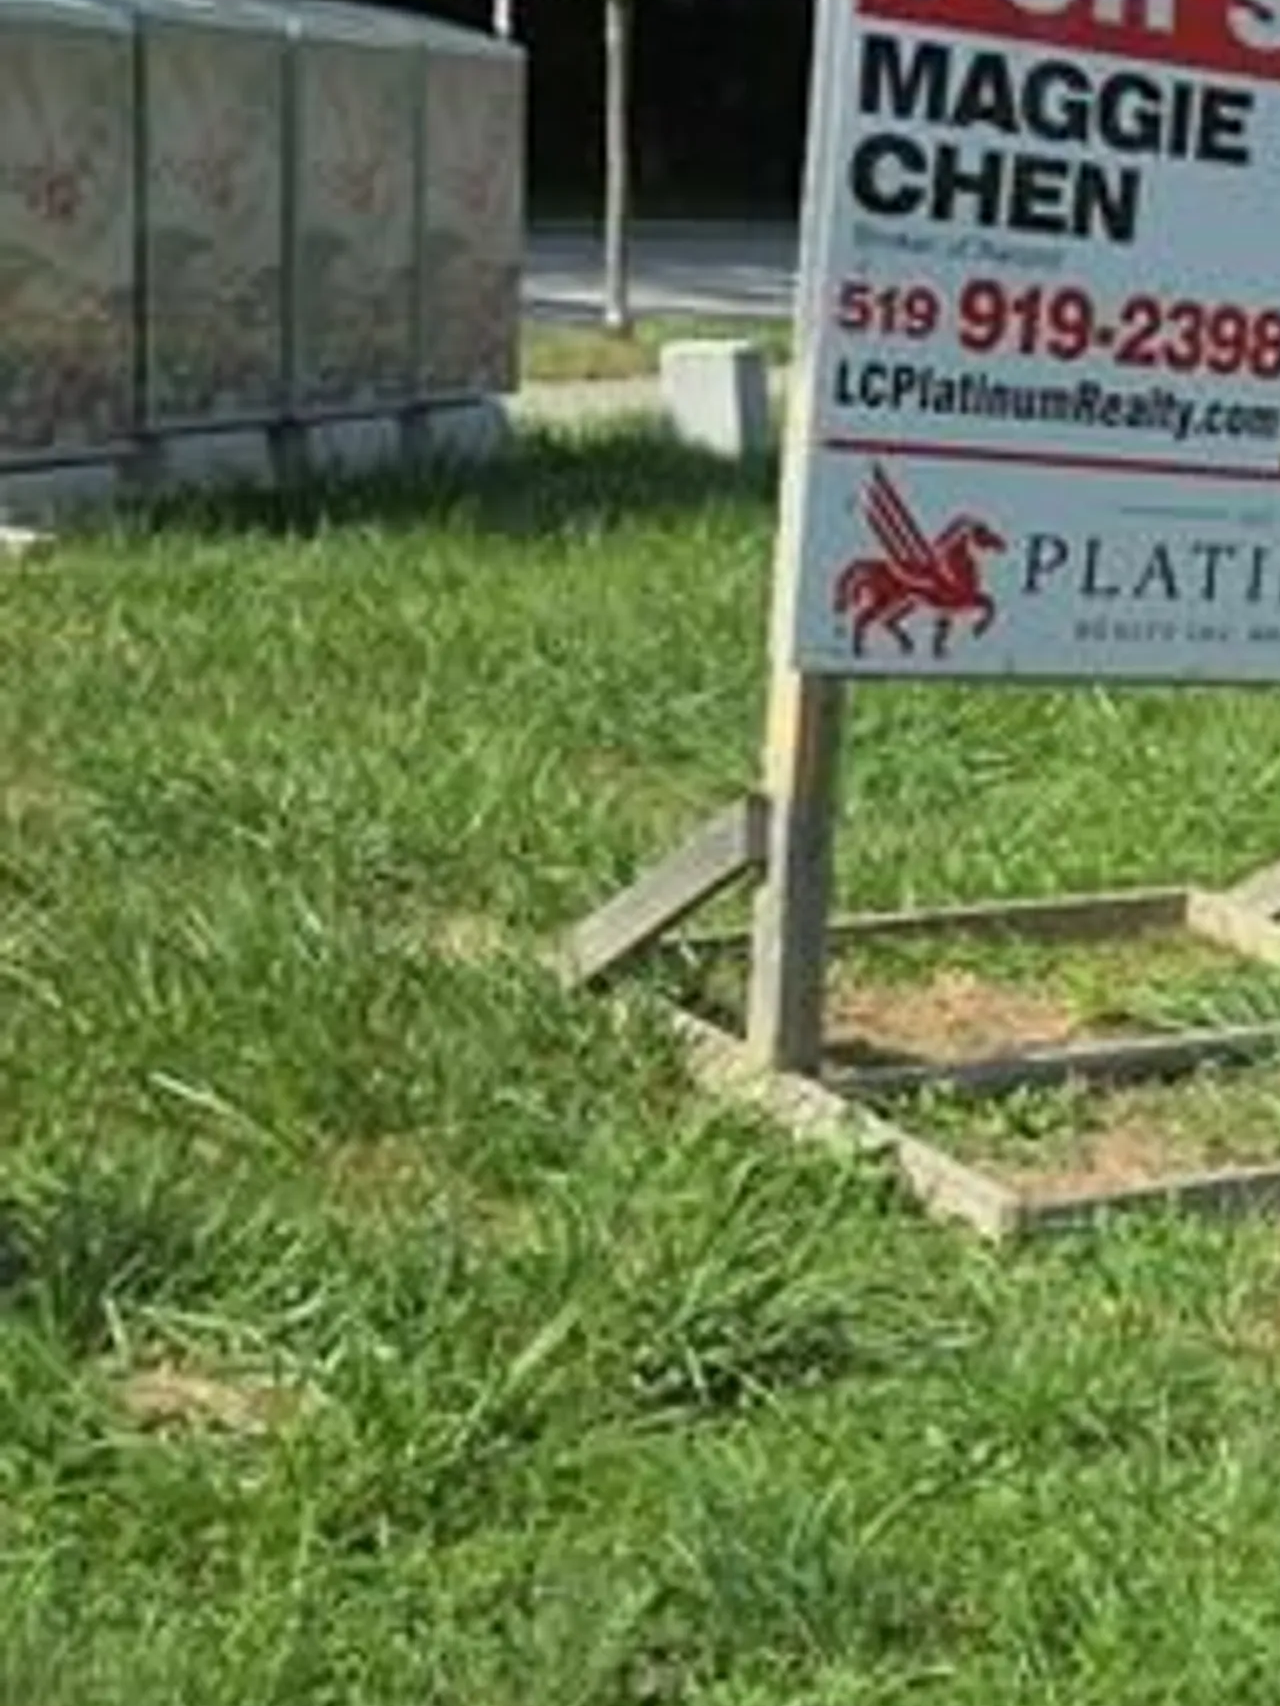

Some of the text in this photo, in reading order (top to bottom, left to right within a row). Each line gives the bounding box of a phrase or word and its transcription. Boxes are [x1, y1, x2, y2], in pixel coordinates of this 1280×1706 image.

[860, 36, 1255, 165] MAGGIE
[850, 134, 1140, 243] CHEN
[838, 280, 939, 339] 519
[834, 358, 1280, 439] LCPlatinumRealty.com
